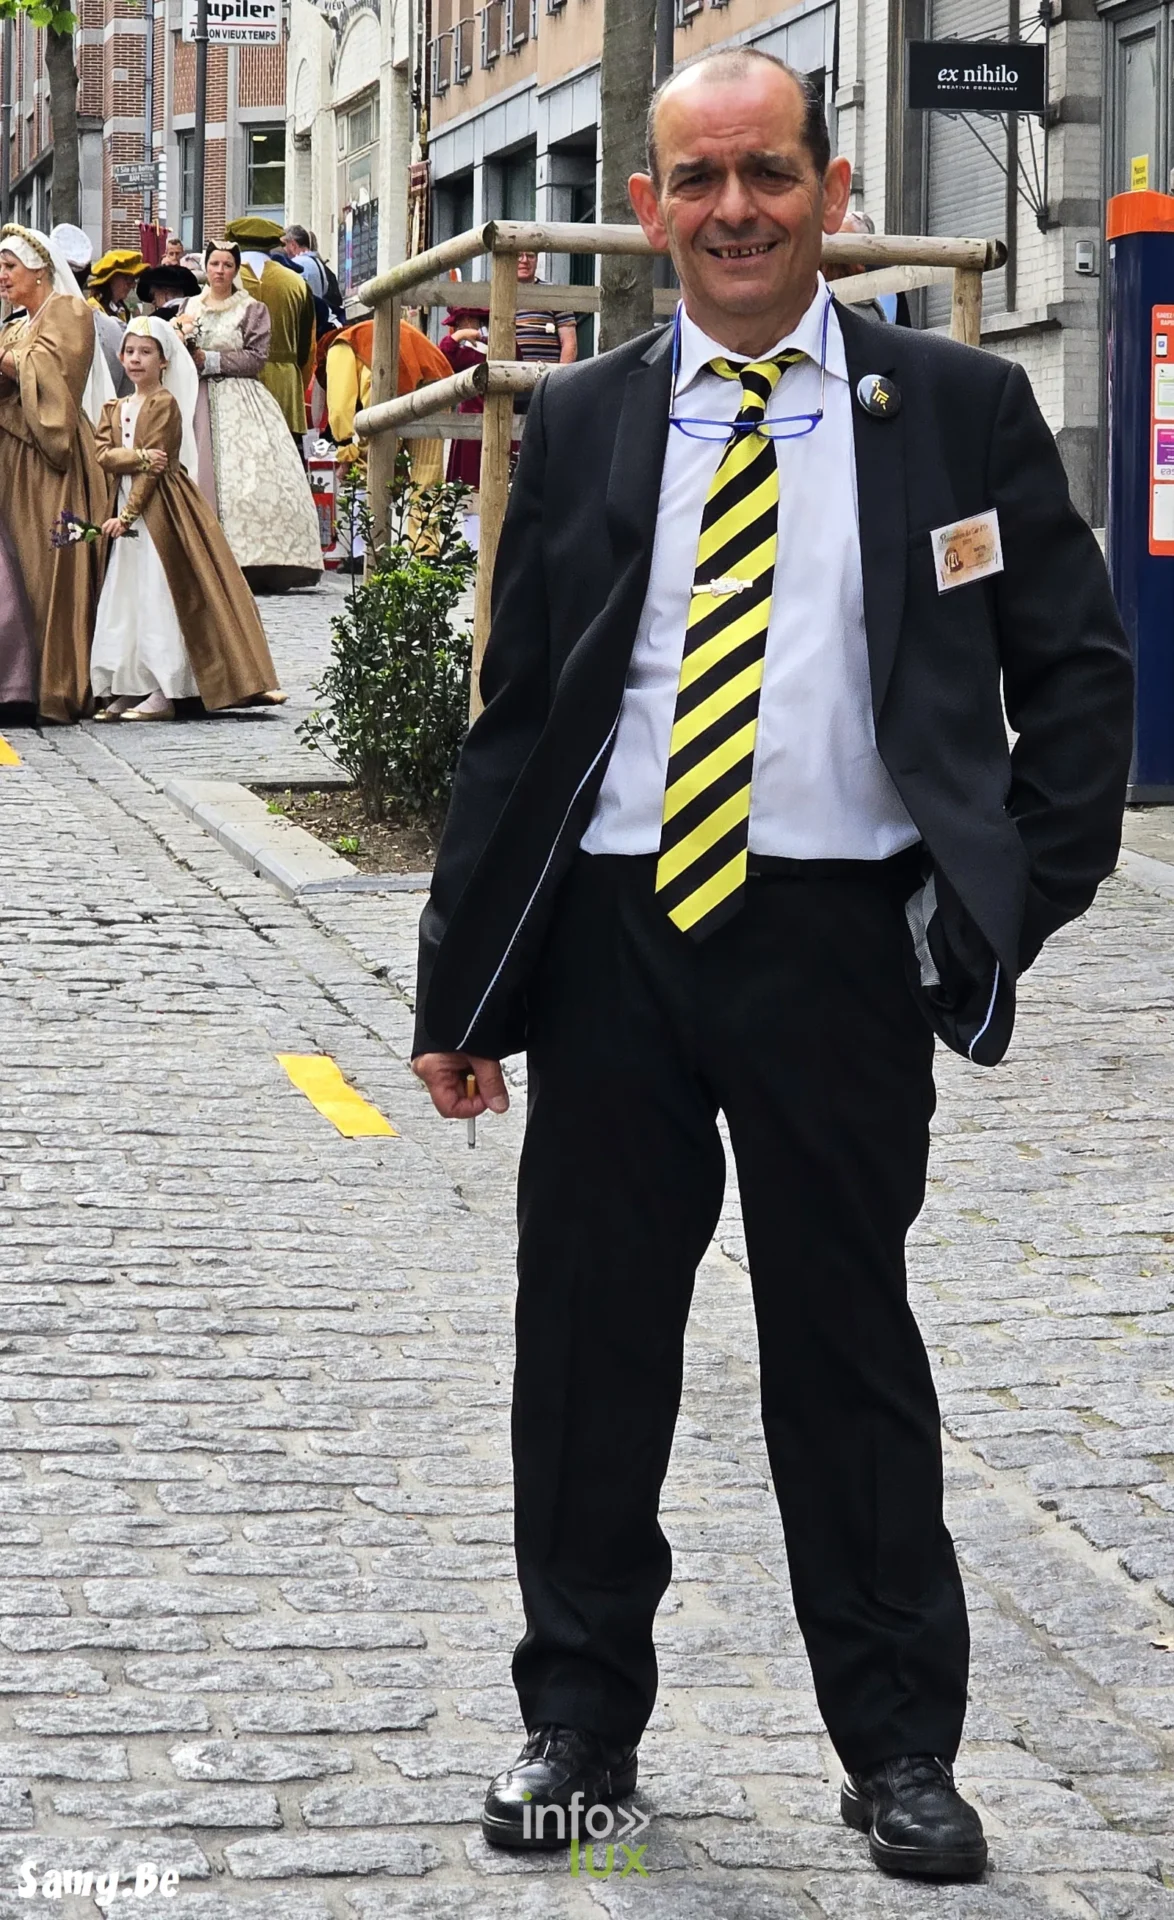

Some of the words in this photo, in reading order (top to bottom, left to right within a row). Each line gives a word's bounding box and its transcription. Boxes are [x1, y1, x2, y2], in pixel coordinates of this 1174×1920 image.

[193, 0, 275, 21] upiler
[206, 28, 220, 39] ON
[222, 29, 248, 40] VIEUX
[248, 30, 276, 41] TEMPS
[937, 68, 959, 82] ex
[963, 63, 1019, 84] nihilo
